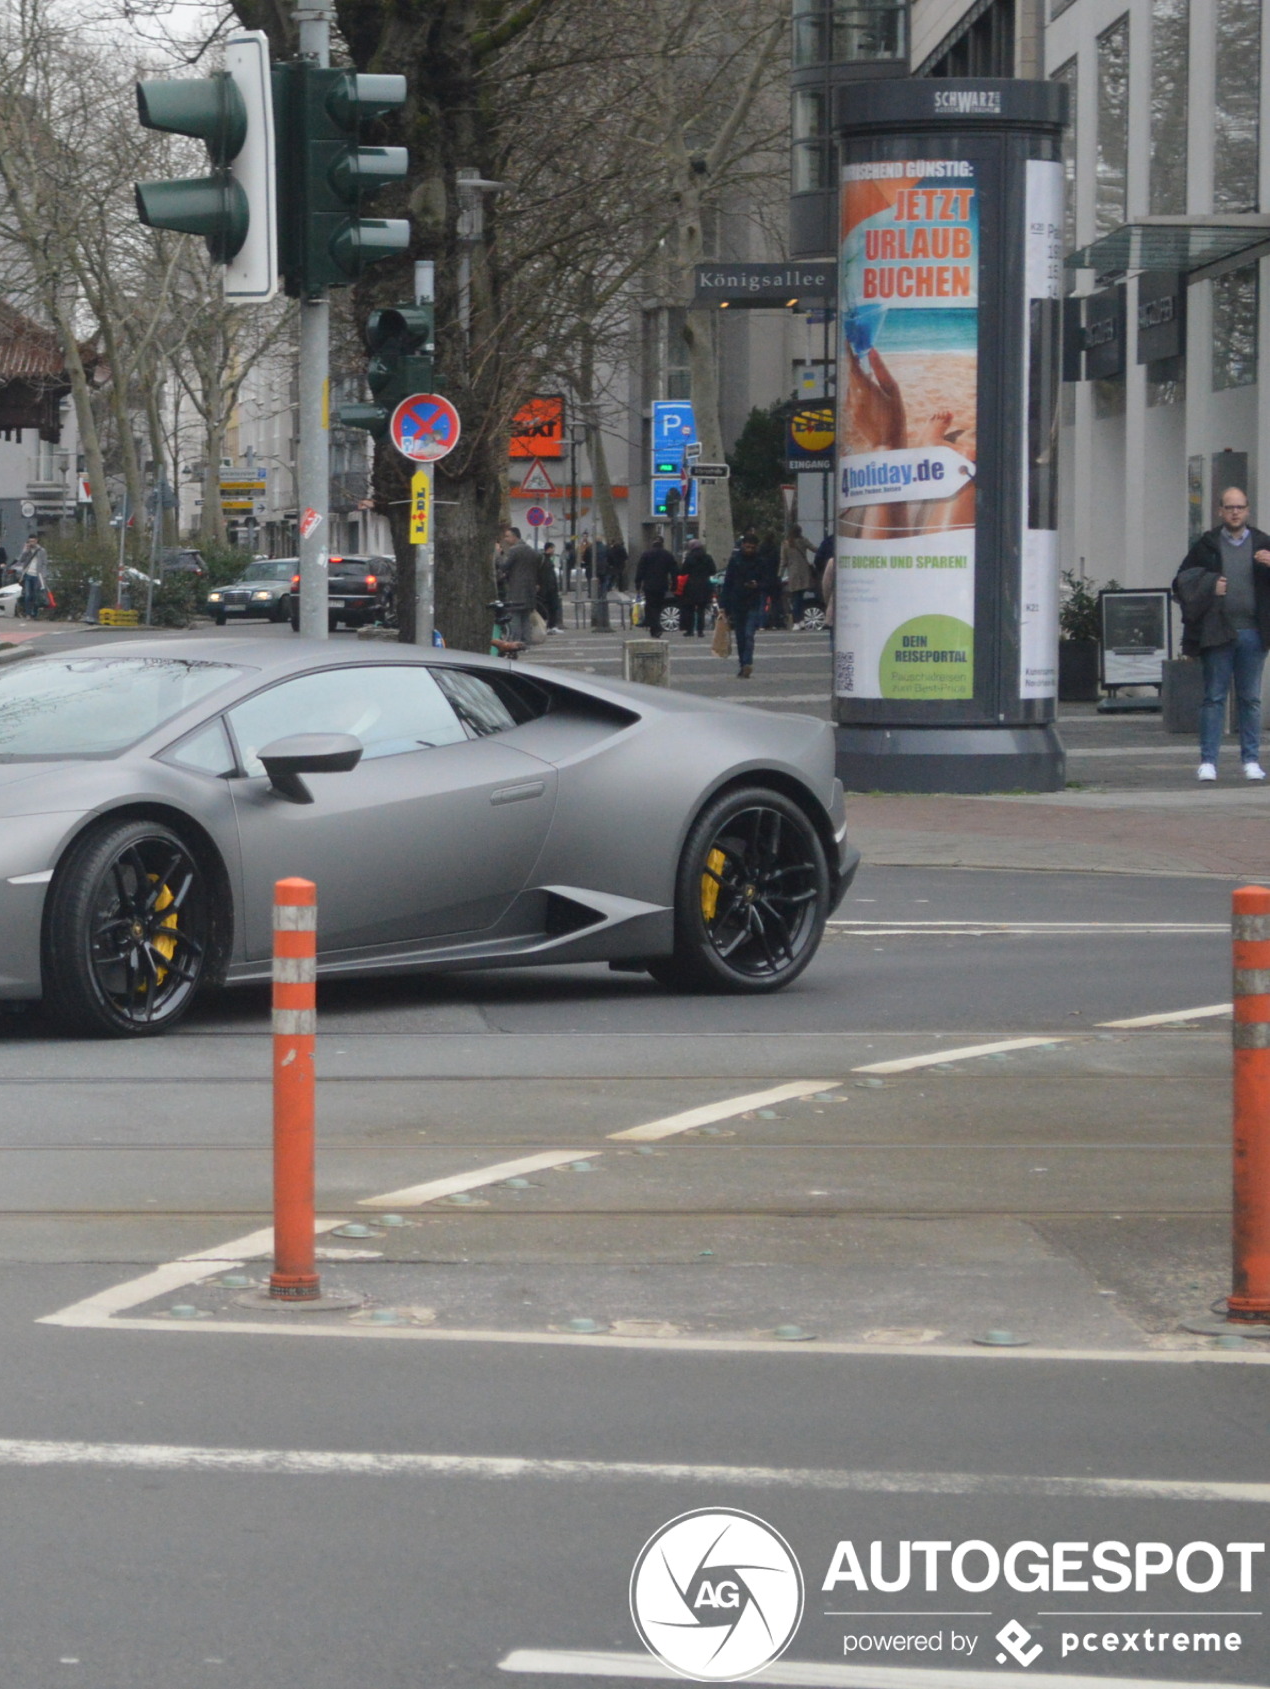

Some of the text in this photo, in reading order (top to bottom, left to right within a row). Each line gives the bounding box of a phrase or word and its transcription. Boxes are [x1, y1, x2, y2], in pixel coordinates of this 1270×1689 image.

[905, 160, 974, 178] GÜNSTIG:
[894, 188, 975, 221] JETZT
[865, 227, 972, 261] URLAUB
[700, 271, 825, 292] Königsallee
[863, 265, 971, 299] BUCHEN
[663, 415, 681, 436] P
[788, 460, 831, 470] EINGANG
[842, 459, 945, 497] 4holiday.de
[412, 487, 427, 533] LIDL
[852, 555, 888, 569] BUCHEN
[890, 555, 913, 569] UND
[916, 555, 968, 569] SPAREN!
[902, 635, 928, 648] DEIN
[895, 650, 967, 663] REISEPORTAL
